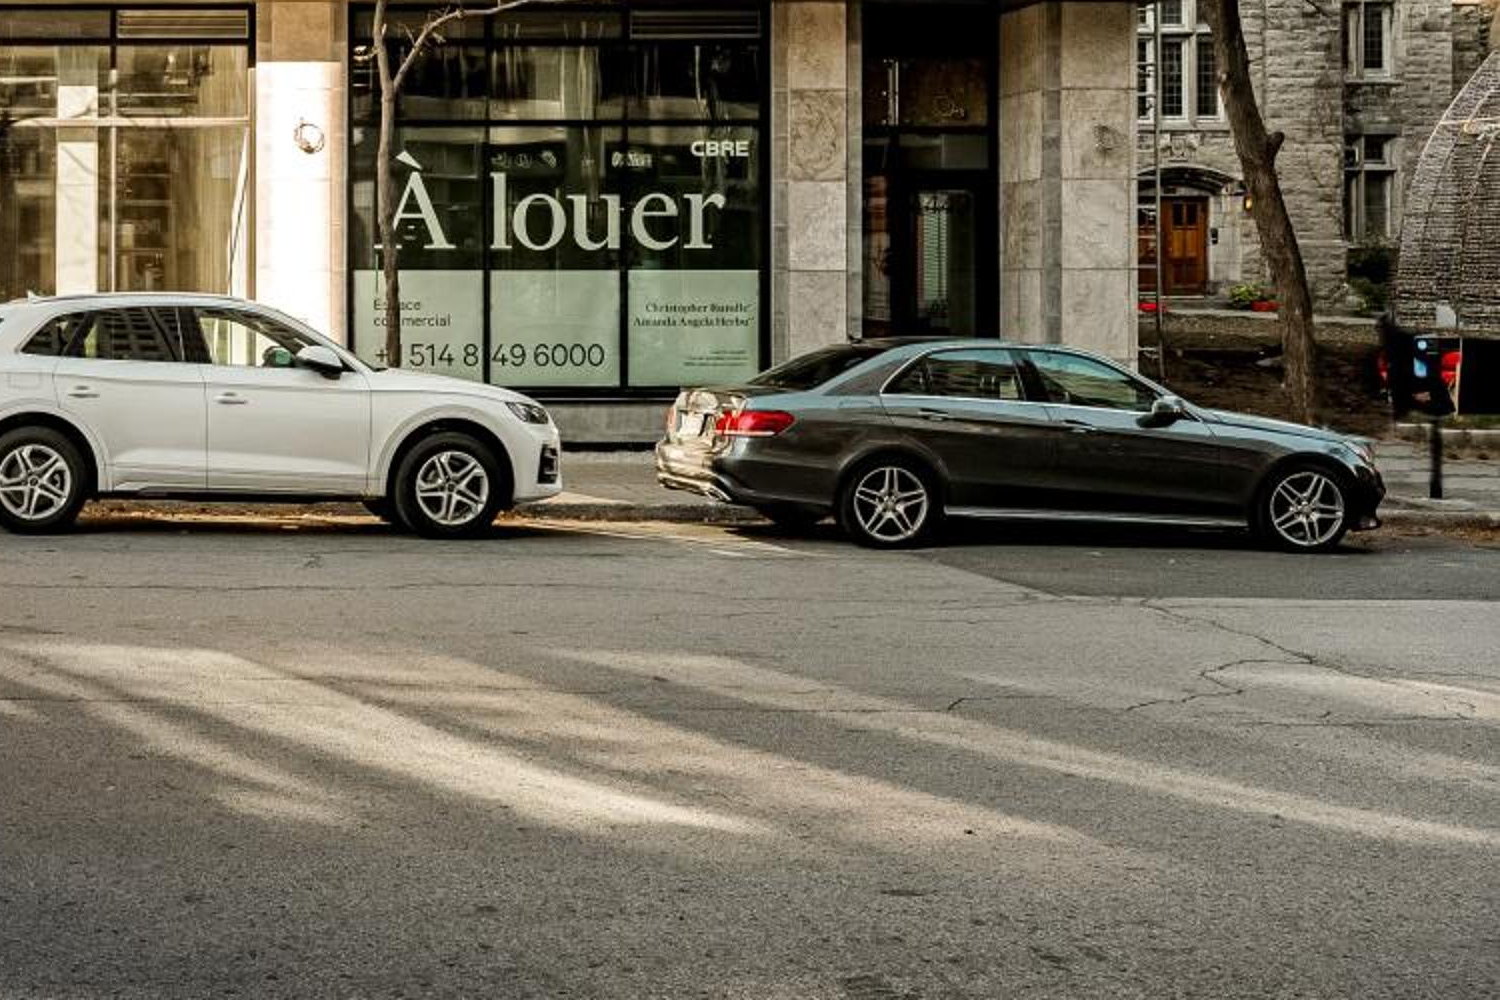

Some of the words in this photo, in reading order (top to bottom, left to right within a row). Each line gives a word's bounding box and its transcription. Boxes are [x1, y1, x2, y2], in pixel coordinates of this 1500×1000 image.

[690, 140, 750, 158] CBRE
[489, 171, 726, 251] louer
[373, 313, 451, 327] comercial
[409, 343, 455, 367] 514
[533, 343, 605, 367] 6000
